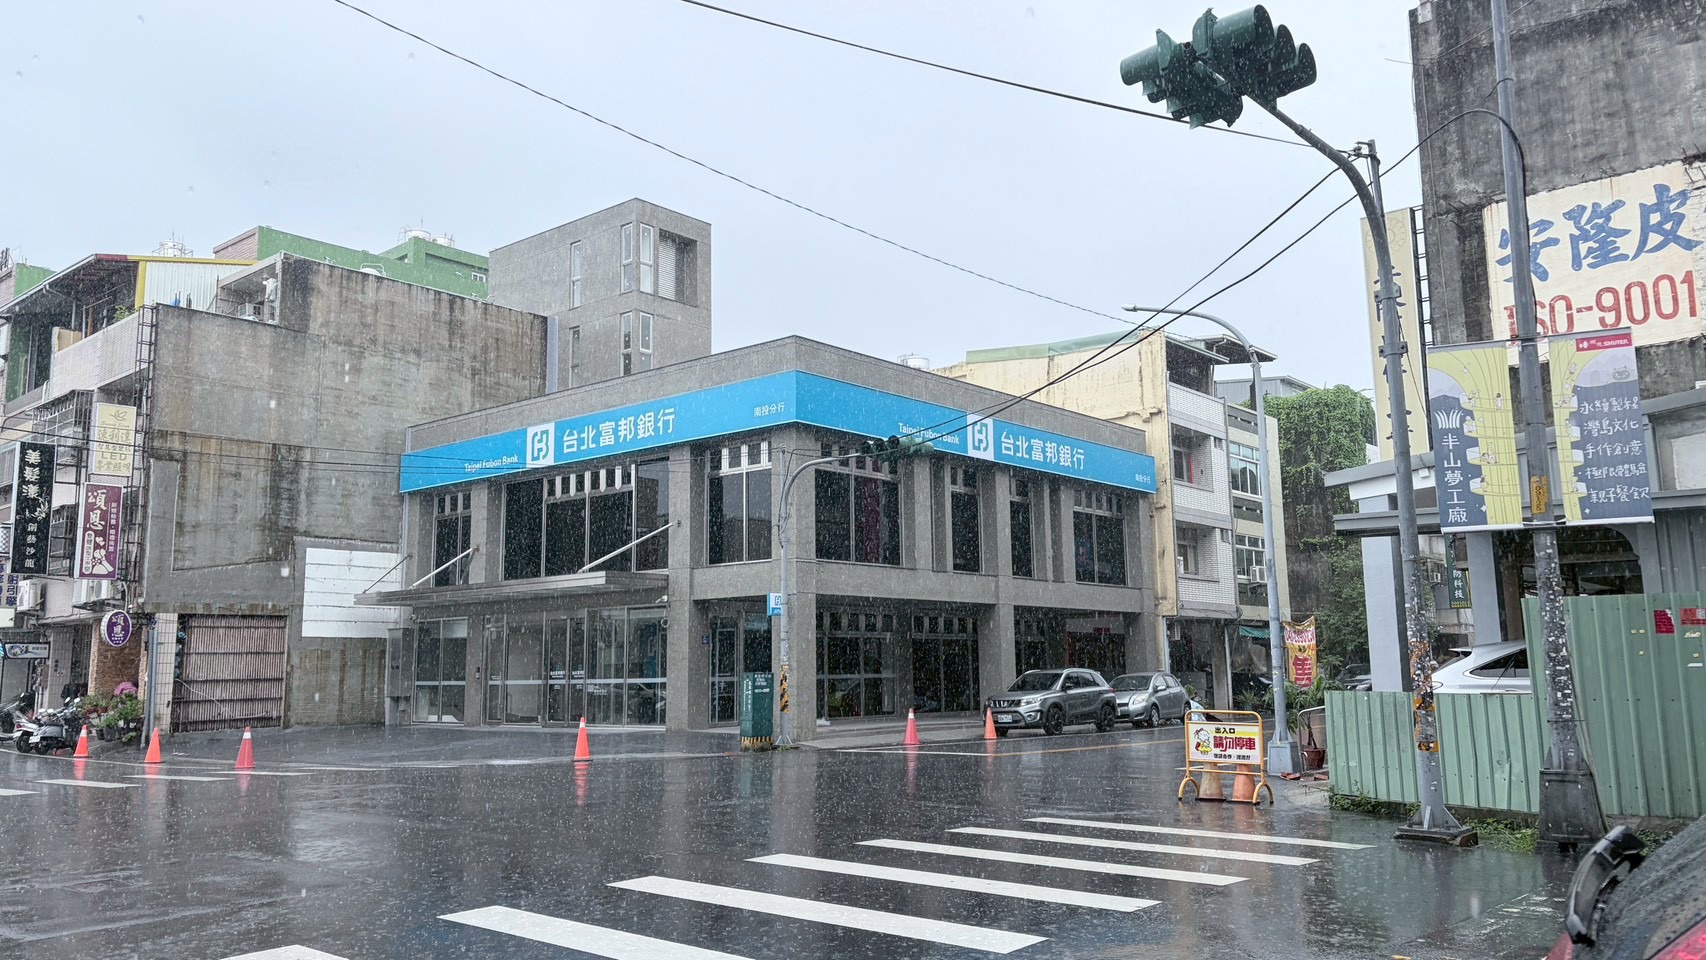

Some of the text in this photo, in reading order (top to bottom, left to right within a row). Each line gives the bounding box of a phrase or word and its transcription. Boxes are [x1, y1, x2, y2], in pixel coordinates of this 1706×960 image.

[753, 401, 786, 418] 南投分行
[1580, 396, 1639, 415] 永續製程
[562, 407, 676, 454] 台北富邦銀行
[898, 422, 960, 445] Taipei Fubon Bank
[1584, 416, 1639, 437] 灣島文化
[101, 452, 127, 461] LED
[1000, 430, 1085, 471] 台北富邦銀行
[1584, 439, 1643, 459] 手作創意
[464, 453, 519, 473] Taipei Fubon Bank
[1585, 462, 1648, 480] 極限體驗
[1441, 432, 1468, 524] 半山夢工廠
[1588, 484, 1650, 503] 親子餐飲
[1214, 726, 1236, 735] 出入口
[1213, 735, 1257, 752] 請勿停車
